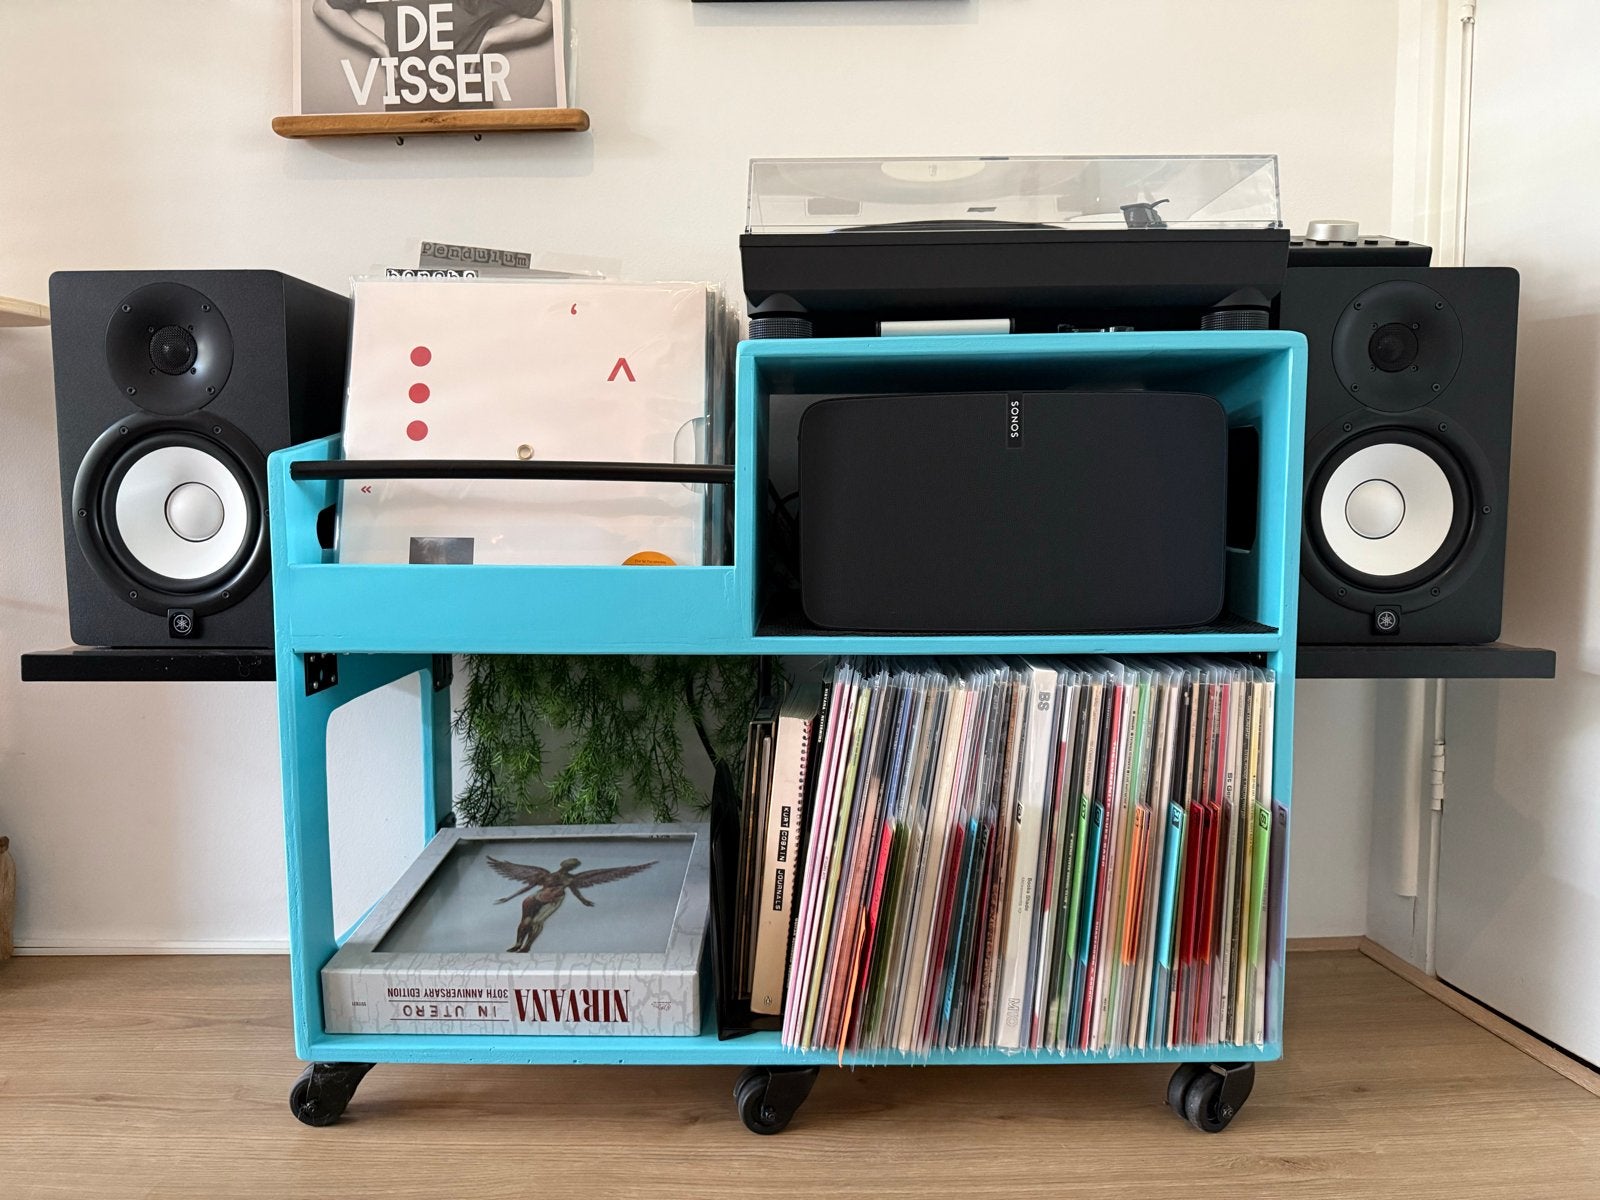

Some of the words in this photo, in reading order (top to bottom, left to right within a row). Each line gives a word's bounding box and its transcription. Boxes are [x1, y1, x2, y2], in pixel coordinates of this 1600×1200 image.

[397, 3, 454, 52] DE
[340, 53, 512, 106] VISSER
[422, 242, 528, 267] pendulum
[1010, 400, 1020, 438] SONOS
[1037, 691, 1051, 711] BS
[781, 806, 791, 828] KURT
[778, 830, 788, 862] COBAIN
[774, 869, 784, 911] JOURNALS
[387, 987, 420, 998] EDITION
[423, 988, 483, 999] ANNIVERSARY
[486, 989, 509, 999] 30TH
[402, 1004, 464, 1018] UTERO
[478, 1005, 497, 1018] IN
[514, 988, 631, 1023] NIRVANA
